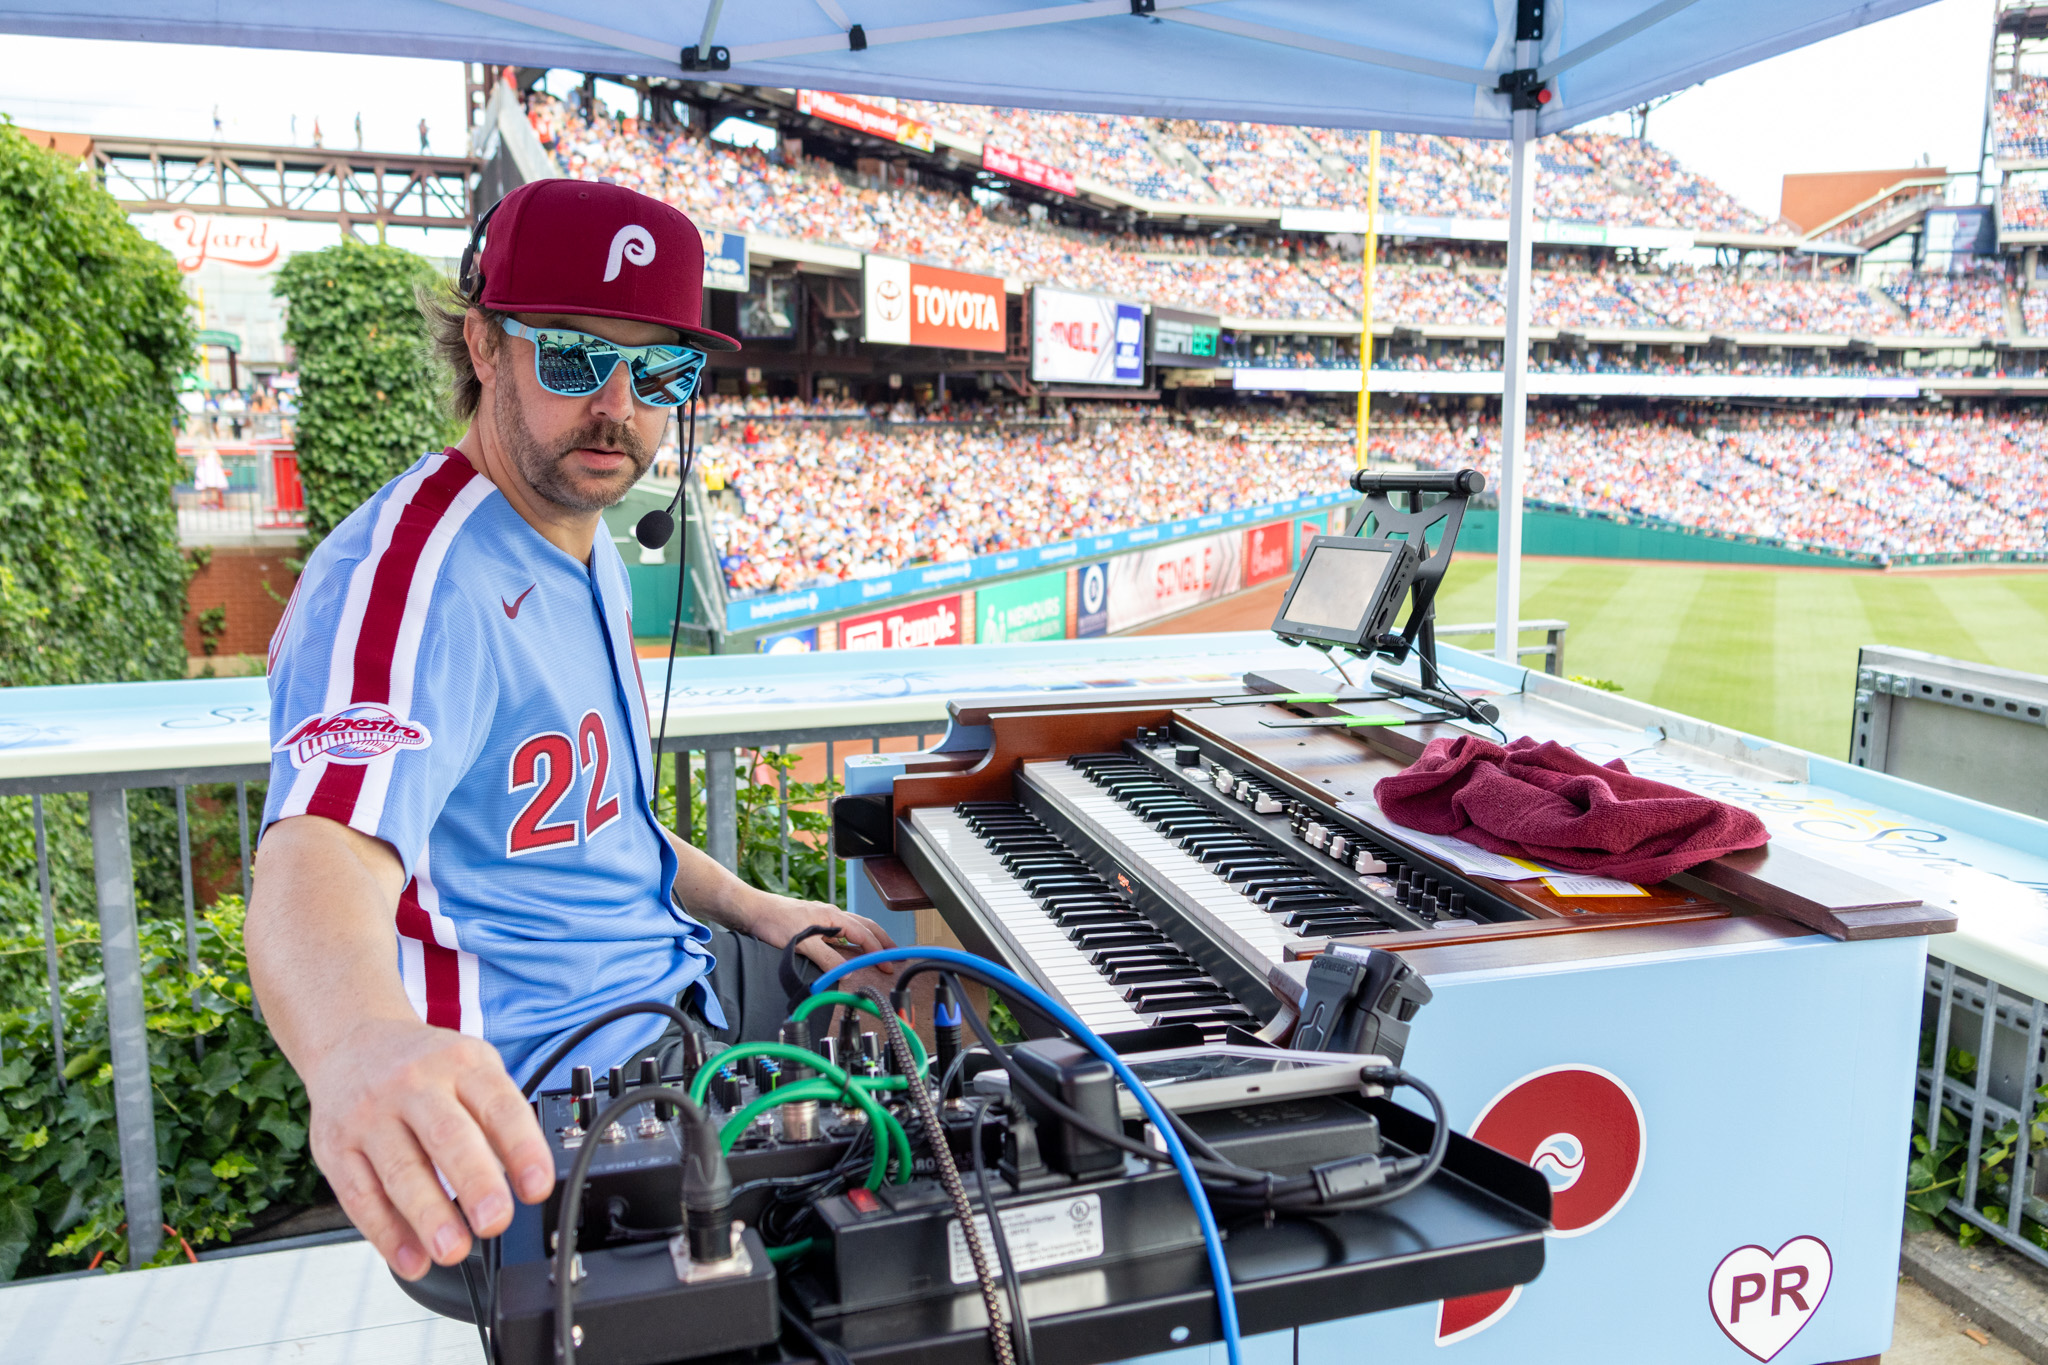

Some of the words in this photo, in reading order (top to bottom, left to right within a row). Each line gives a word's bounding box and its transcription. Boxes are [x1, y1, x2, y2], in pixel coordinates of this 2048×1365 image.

[173, 214, 279, 272] Yard
[603, 224, 656, 282] P
[912, 284, 1000, 332] TOYOTA
[887, 604, 957, 647] Temple
[284, 717, 422, 747] Maestro
[506, 708, 622, 859] 22
[1730, 1265, 1810, 1324] PR
